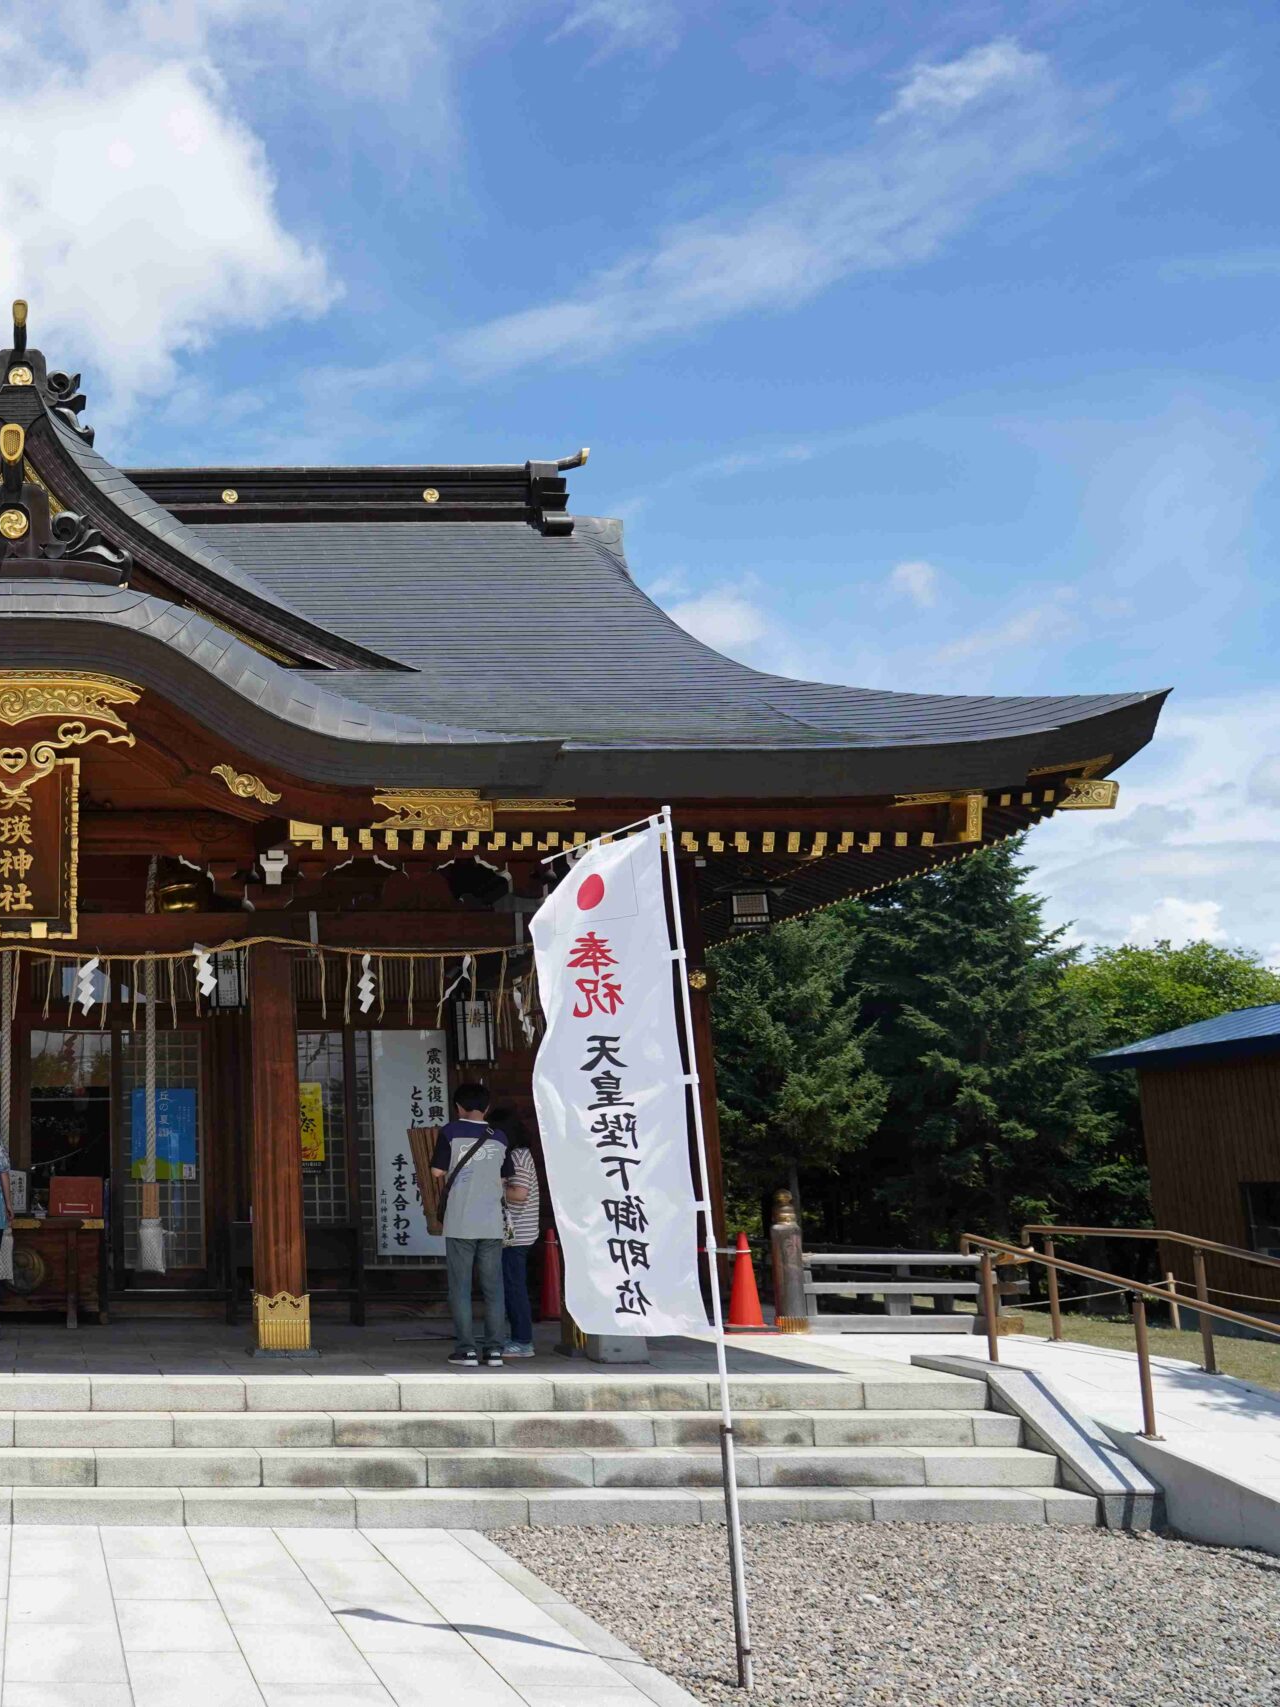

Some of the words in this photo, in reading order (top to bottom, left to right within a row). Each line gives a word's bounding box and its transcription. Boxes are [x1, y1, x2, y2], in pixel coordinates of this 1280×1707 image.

[426, 1047, 445, 1127] 震災復興
[391, 1153, 411, 1246] 手を合わせ
